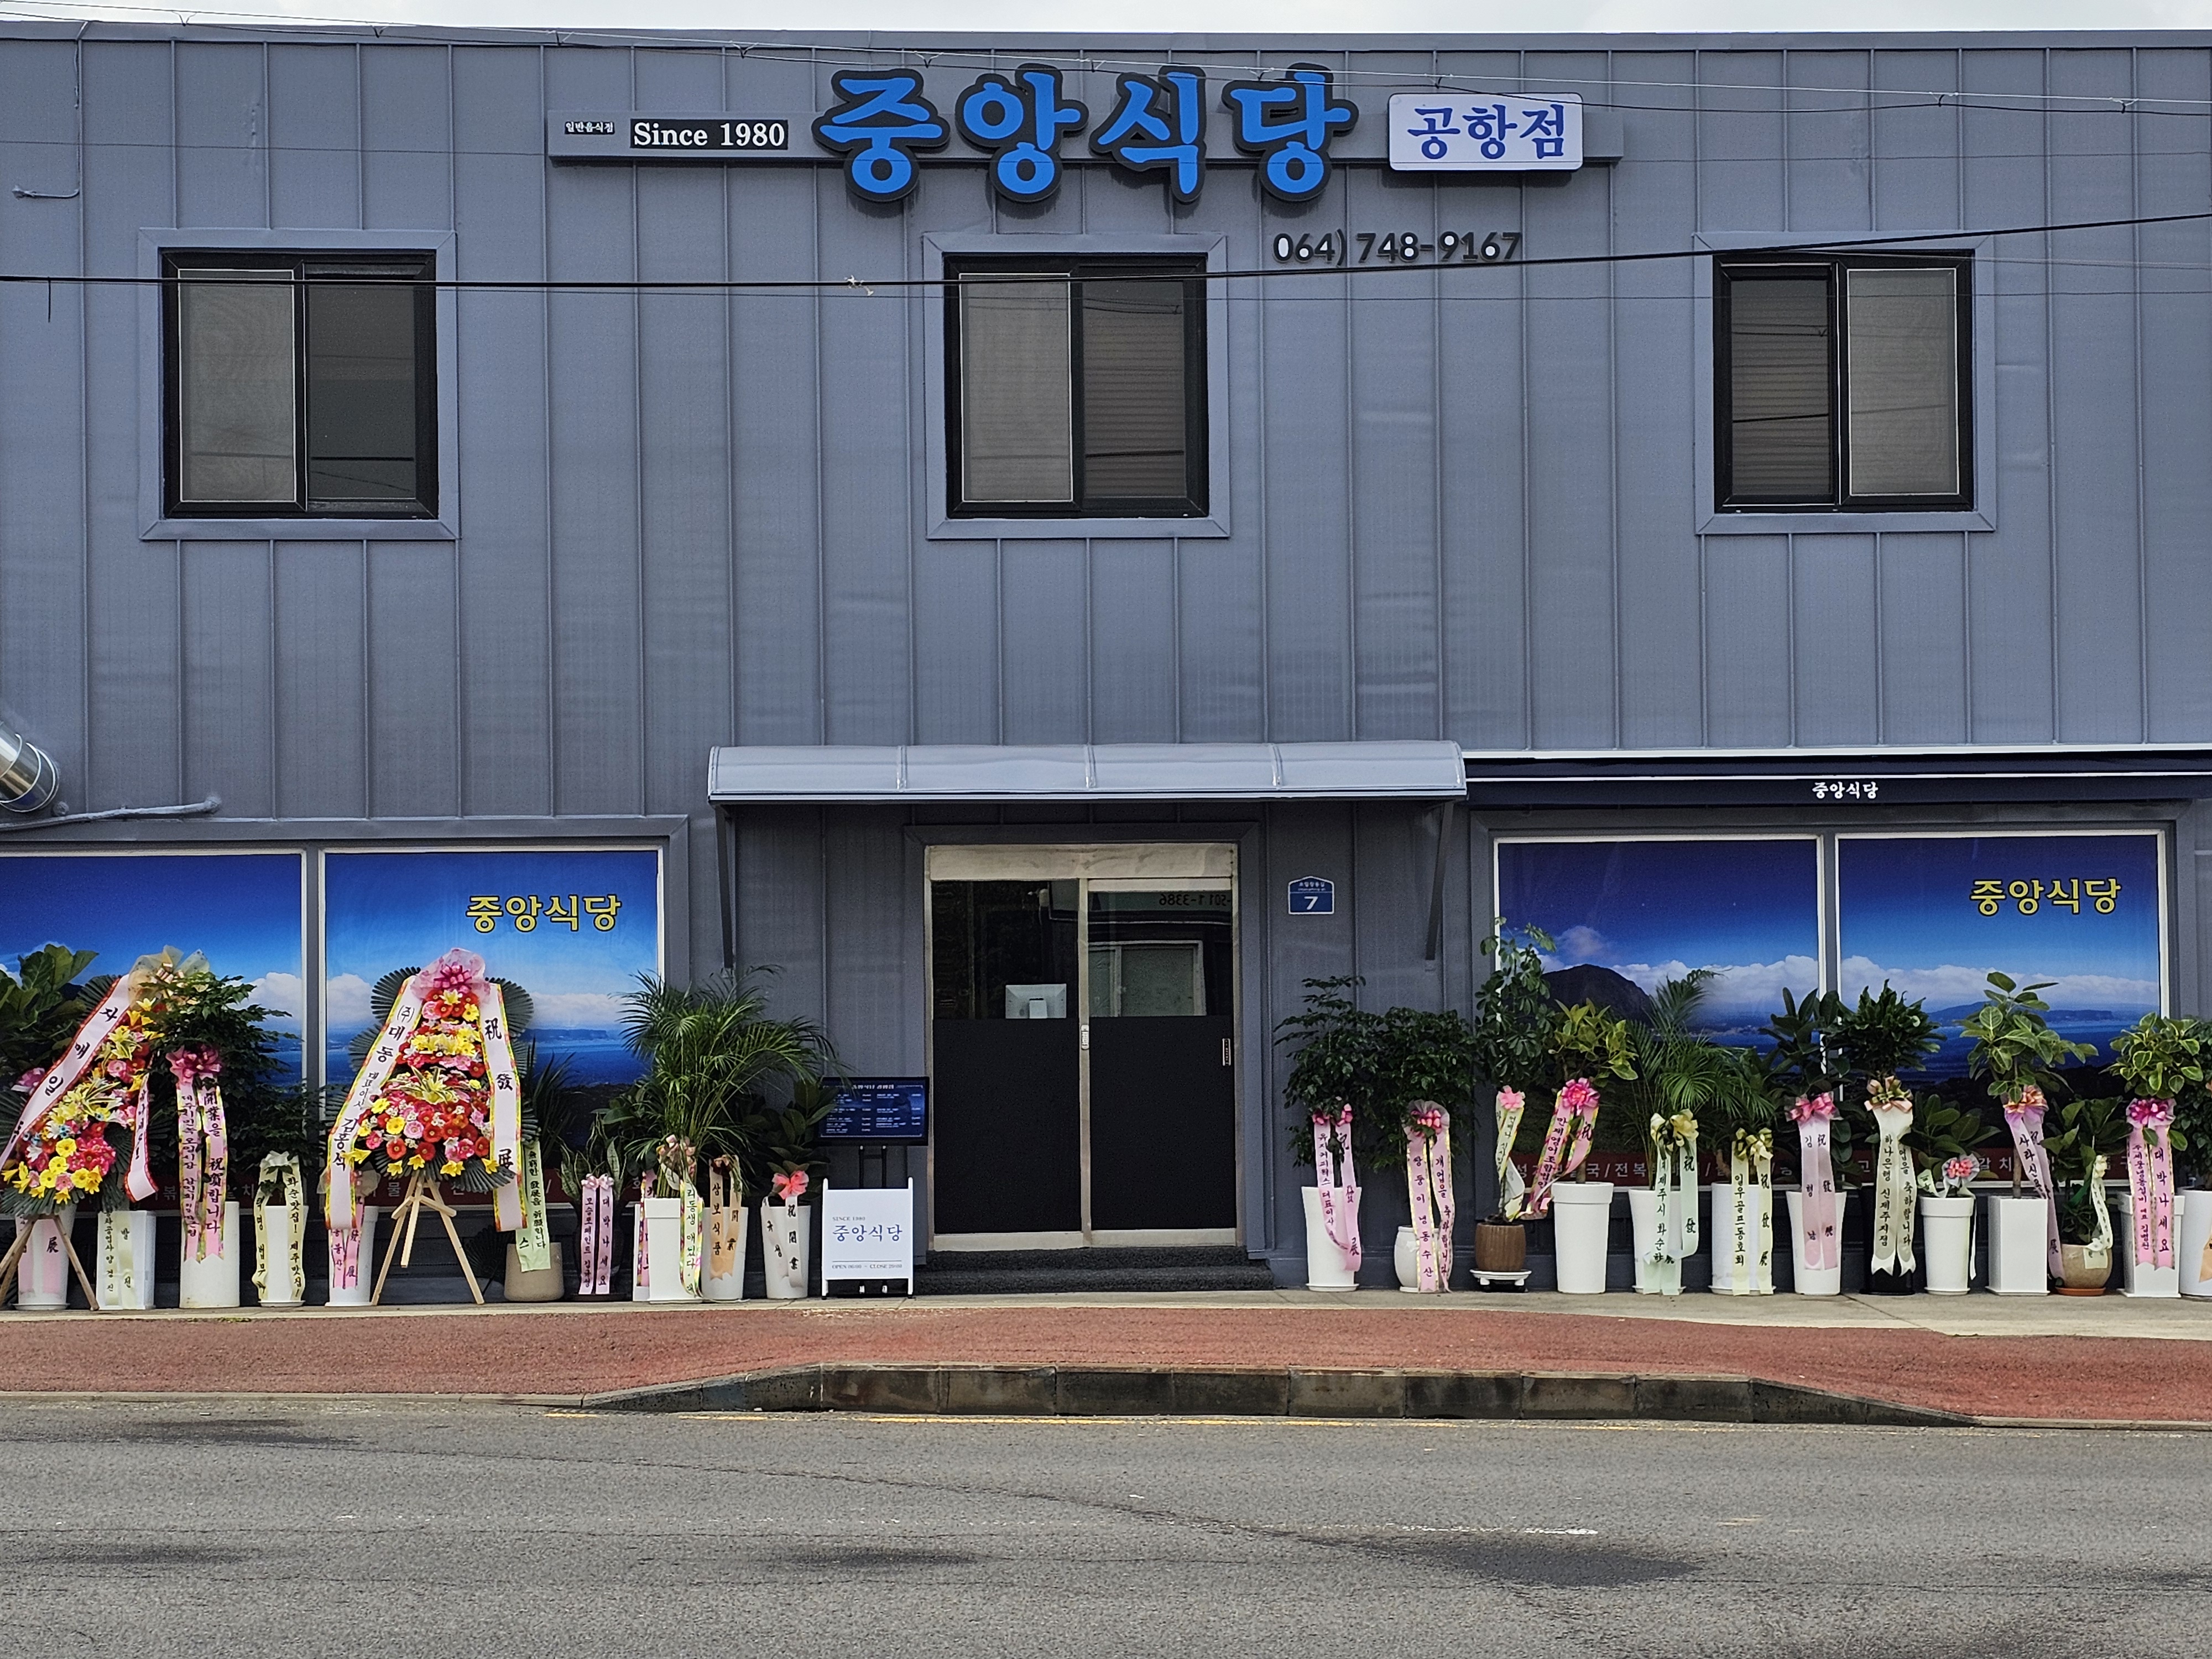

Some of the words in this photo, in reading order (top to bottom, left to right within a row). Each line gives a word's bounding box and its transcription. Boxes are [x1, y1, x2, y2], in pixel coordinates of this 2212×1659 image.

[565, 121, 614, 133] 일반음식점
[634, 122, 708, 146] Since
[720, 123, 785, 147] 1980
[816, 66, 1354, 197] 중앙식당
[1407, 103, 1566, 160] 공항점
[1273, 228, 1347, 267] 064)
[1357, 231, 1522, 264] 748-9167
[1812, 781, 1879, 800] 중앙식당
[466, 894, 623, 933] 중앙식당
[1304, 896, 1318, 910] 7
[1969, 878, 2122, 916] 중앙식당
[1882, 1134, 1893, 1182] 하나은행
[1879, 1187, 1891, 1246] 신제주지점
[2154, 1146, 2170, 1253] 대박나세요
[832, 1223, 903, 1242] 중앙식당
